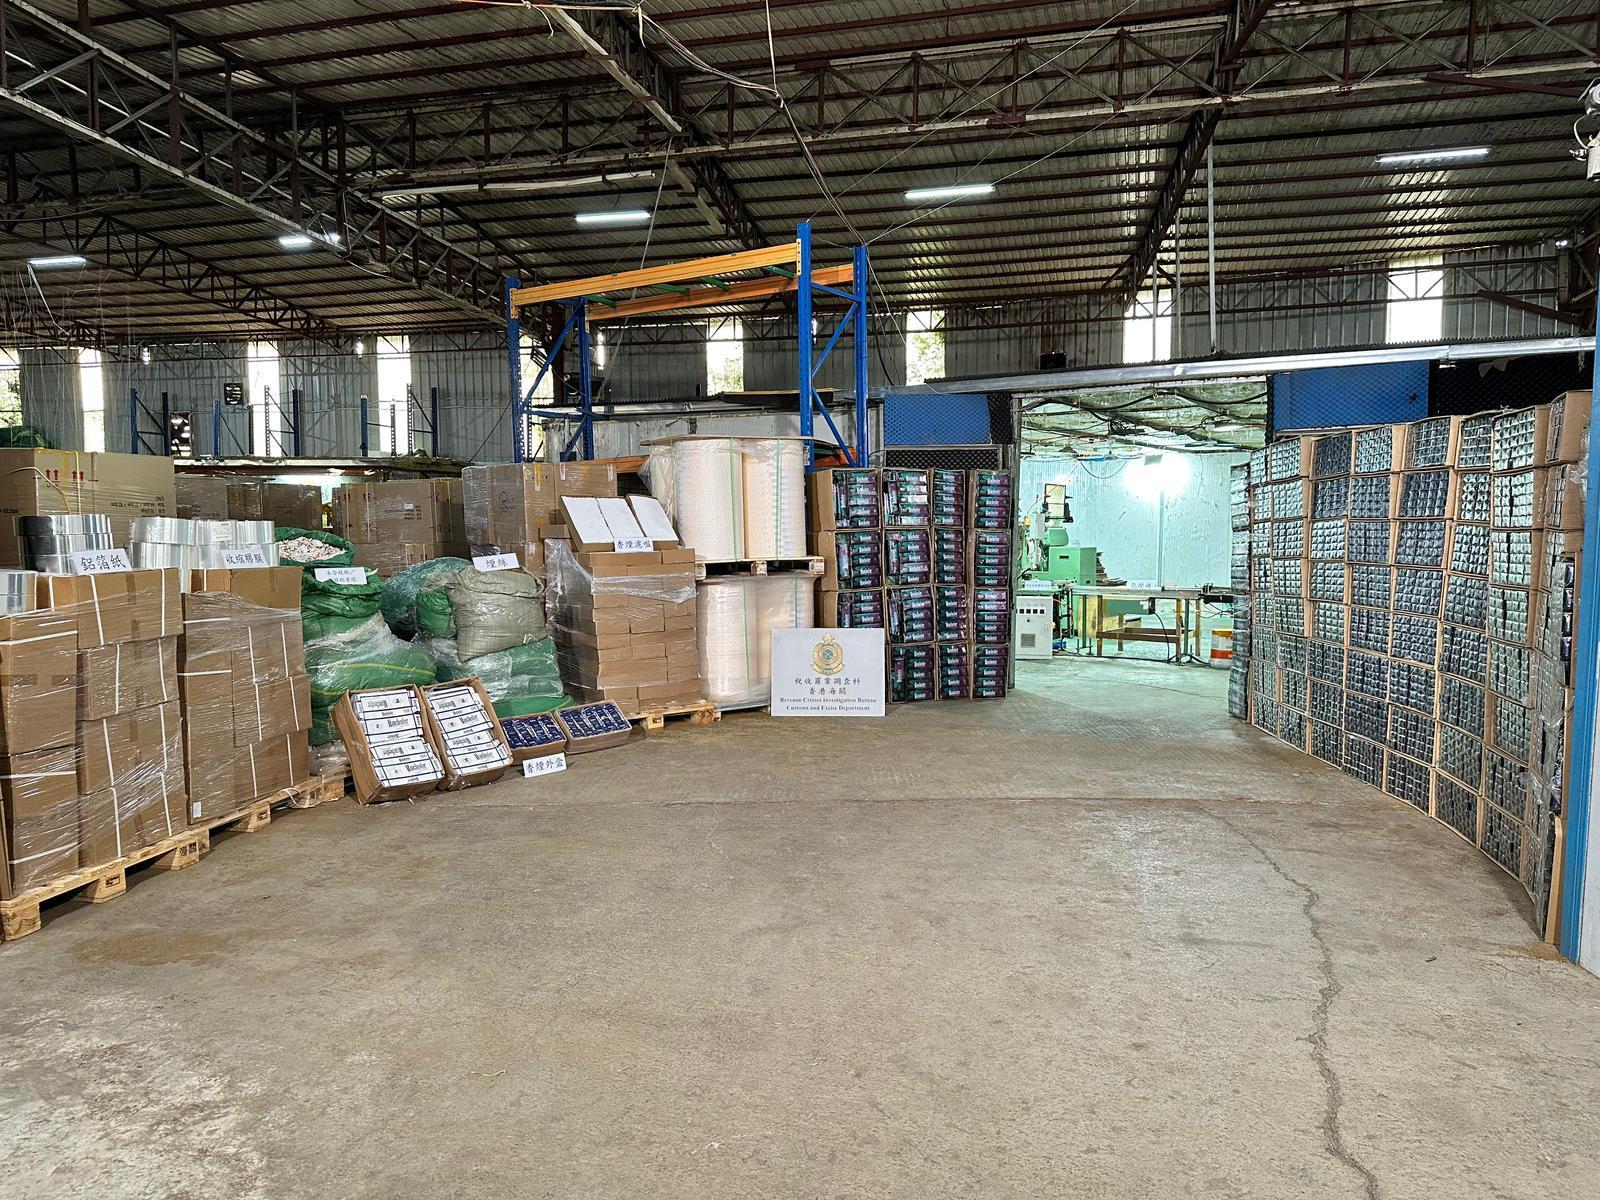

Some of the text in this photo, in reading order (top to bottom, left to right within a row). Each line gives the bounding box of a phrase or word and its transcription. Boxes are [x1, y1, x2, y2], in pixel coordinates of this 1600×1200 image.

[80, 555, 126, 571] 鋁箔紙
[809, 687, 847, 695] 香港海關
